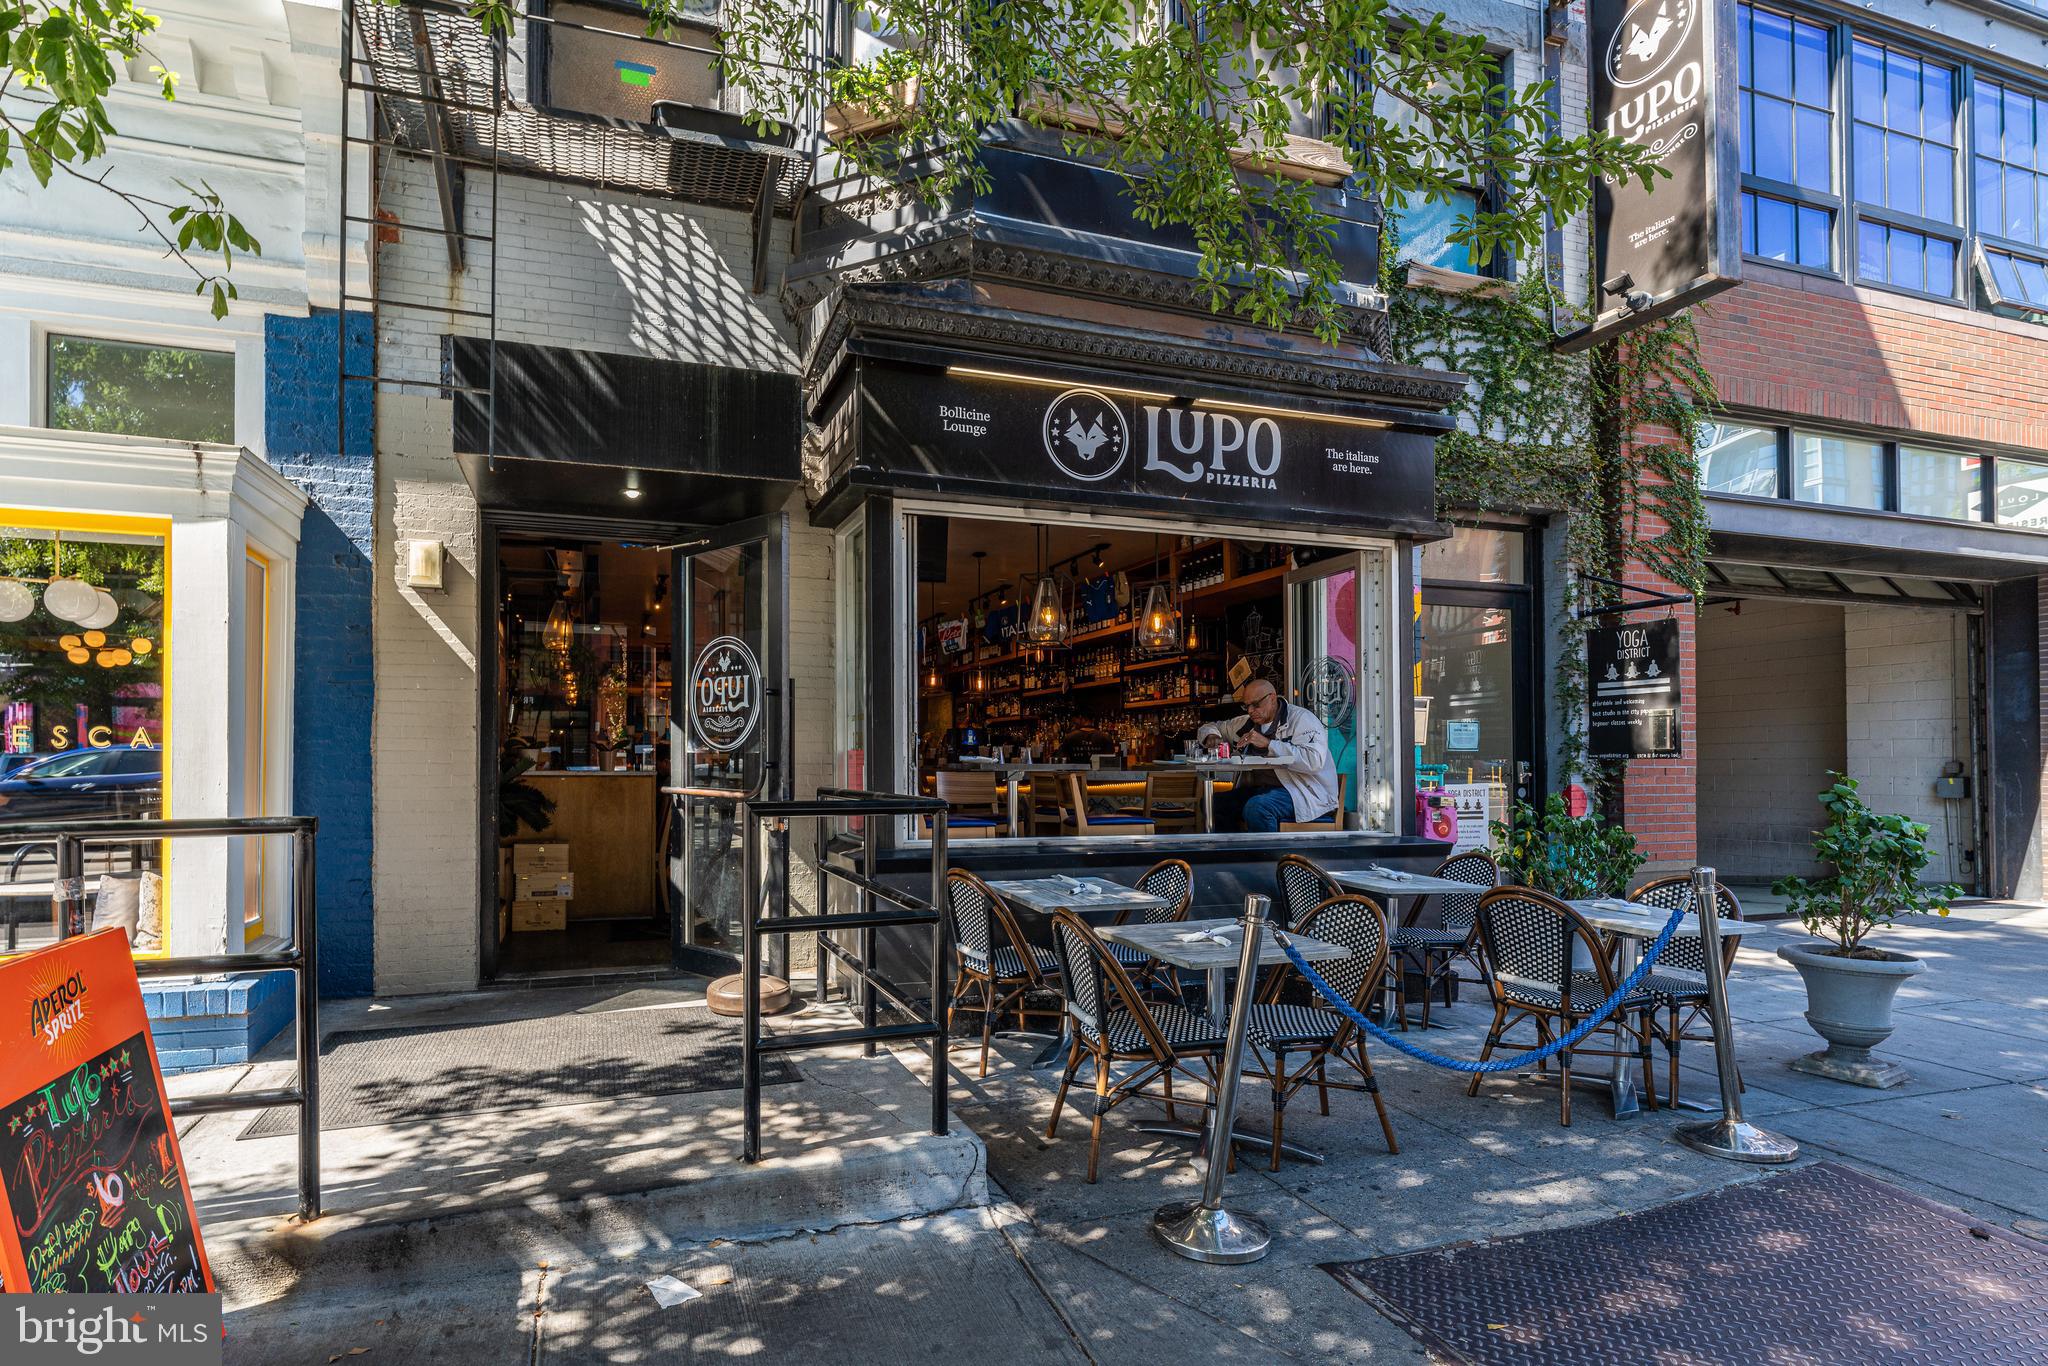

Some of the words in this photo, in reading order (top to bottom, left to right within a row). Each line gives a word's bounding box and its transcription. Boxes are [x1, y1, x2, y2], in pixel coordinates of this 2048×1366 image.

[1605, 61, 1701, 146] LUPO
[1645, 98, 1697, 135] PIZZERIA
[1629, 232, 1645, 243] The
[1645, 215, 1675, 235] italians
[1634, 237, 1648, 249] are
[1648, 228, 1669, 242] here.
[939, 405, 991, 422] Bollicine
[943, 419, 987, 437] Lounge
[1143, 405, 1282, 483] LUPO
[1325, 448, 1344, 460] The
[1345, 450, 1380, 464] italians
[1332, 463, 1348, 472] are
[1349, 462, 1373, 475] here.
[1206, 472, 1278, 490] PIZZERIA
[1616, 629, 1649, 648] YOGA
[1616, 646, 1651, 660] DISTRICT
[1462, 788, 1486, 798] DISTRICT
[31, 972, 87, 1038] APEROL
